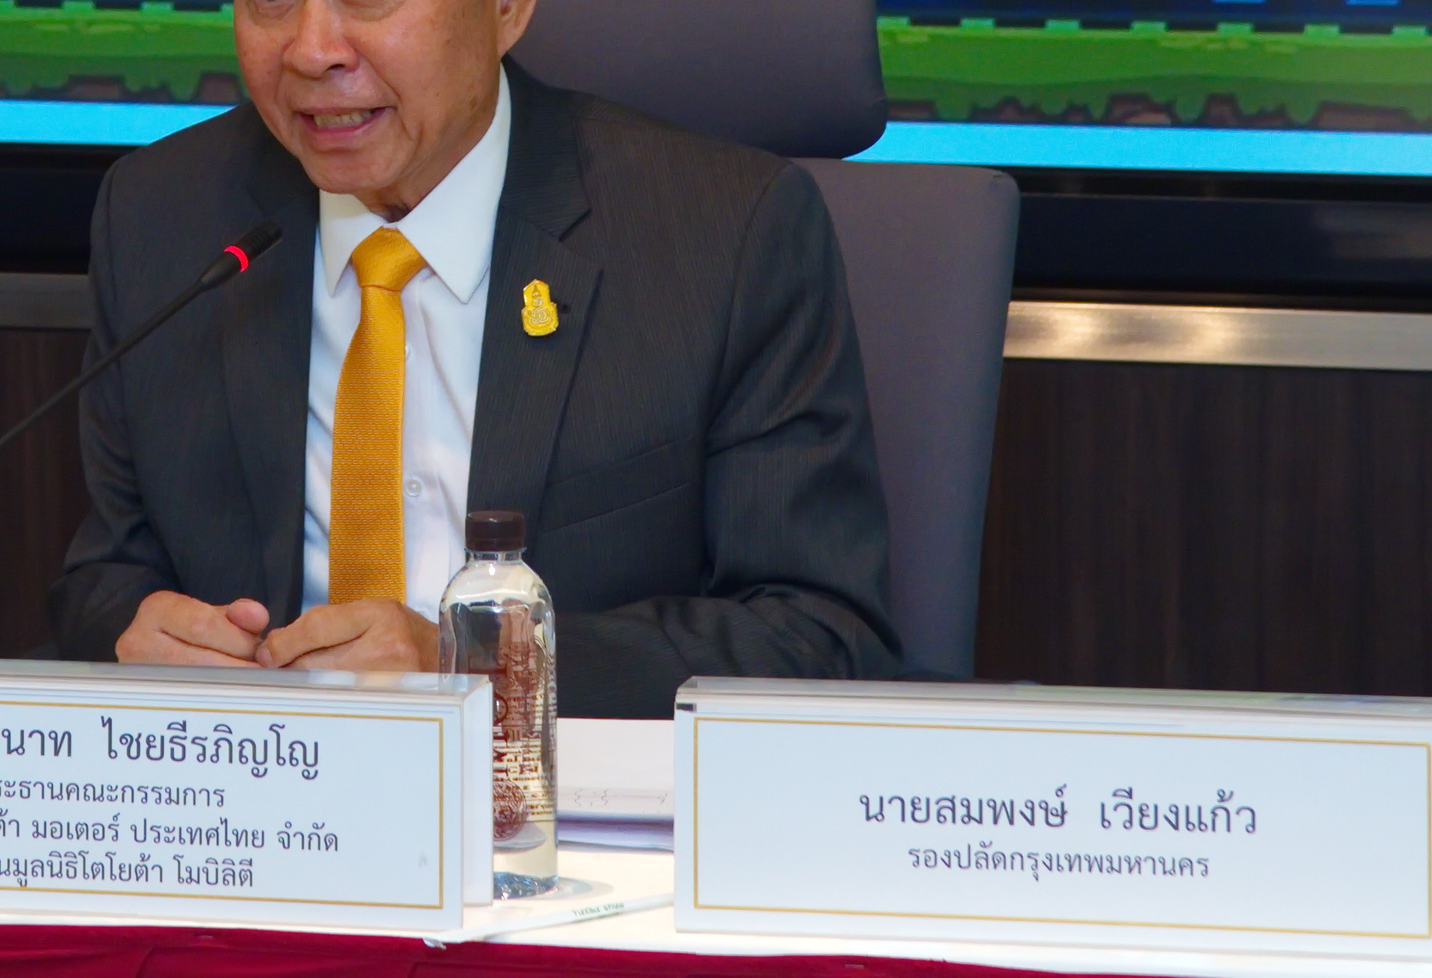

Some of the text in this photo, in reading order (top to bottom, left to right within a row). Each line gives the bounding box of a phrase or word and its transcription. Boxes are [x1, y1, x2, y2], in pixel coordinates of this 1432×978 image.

[101, 714, 320, 780] ไชยธีรภิญโญ
[857, 782, 1257, 835] นายสมพงษ์ เวียงแก้ว
[30, 811, 122, 843] มอเตอร์
[128, 815, 266, 850] ประเทศไทย
[275, 819, 339, 853] จำกัด
[171, 852, 254, 888] โมบิลิตี
[907, 839, 1210, 883] รองปลัดกรุงเทพมหานคร
